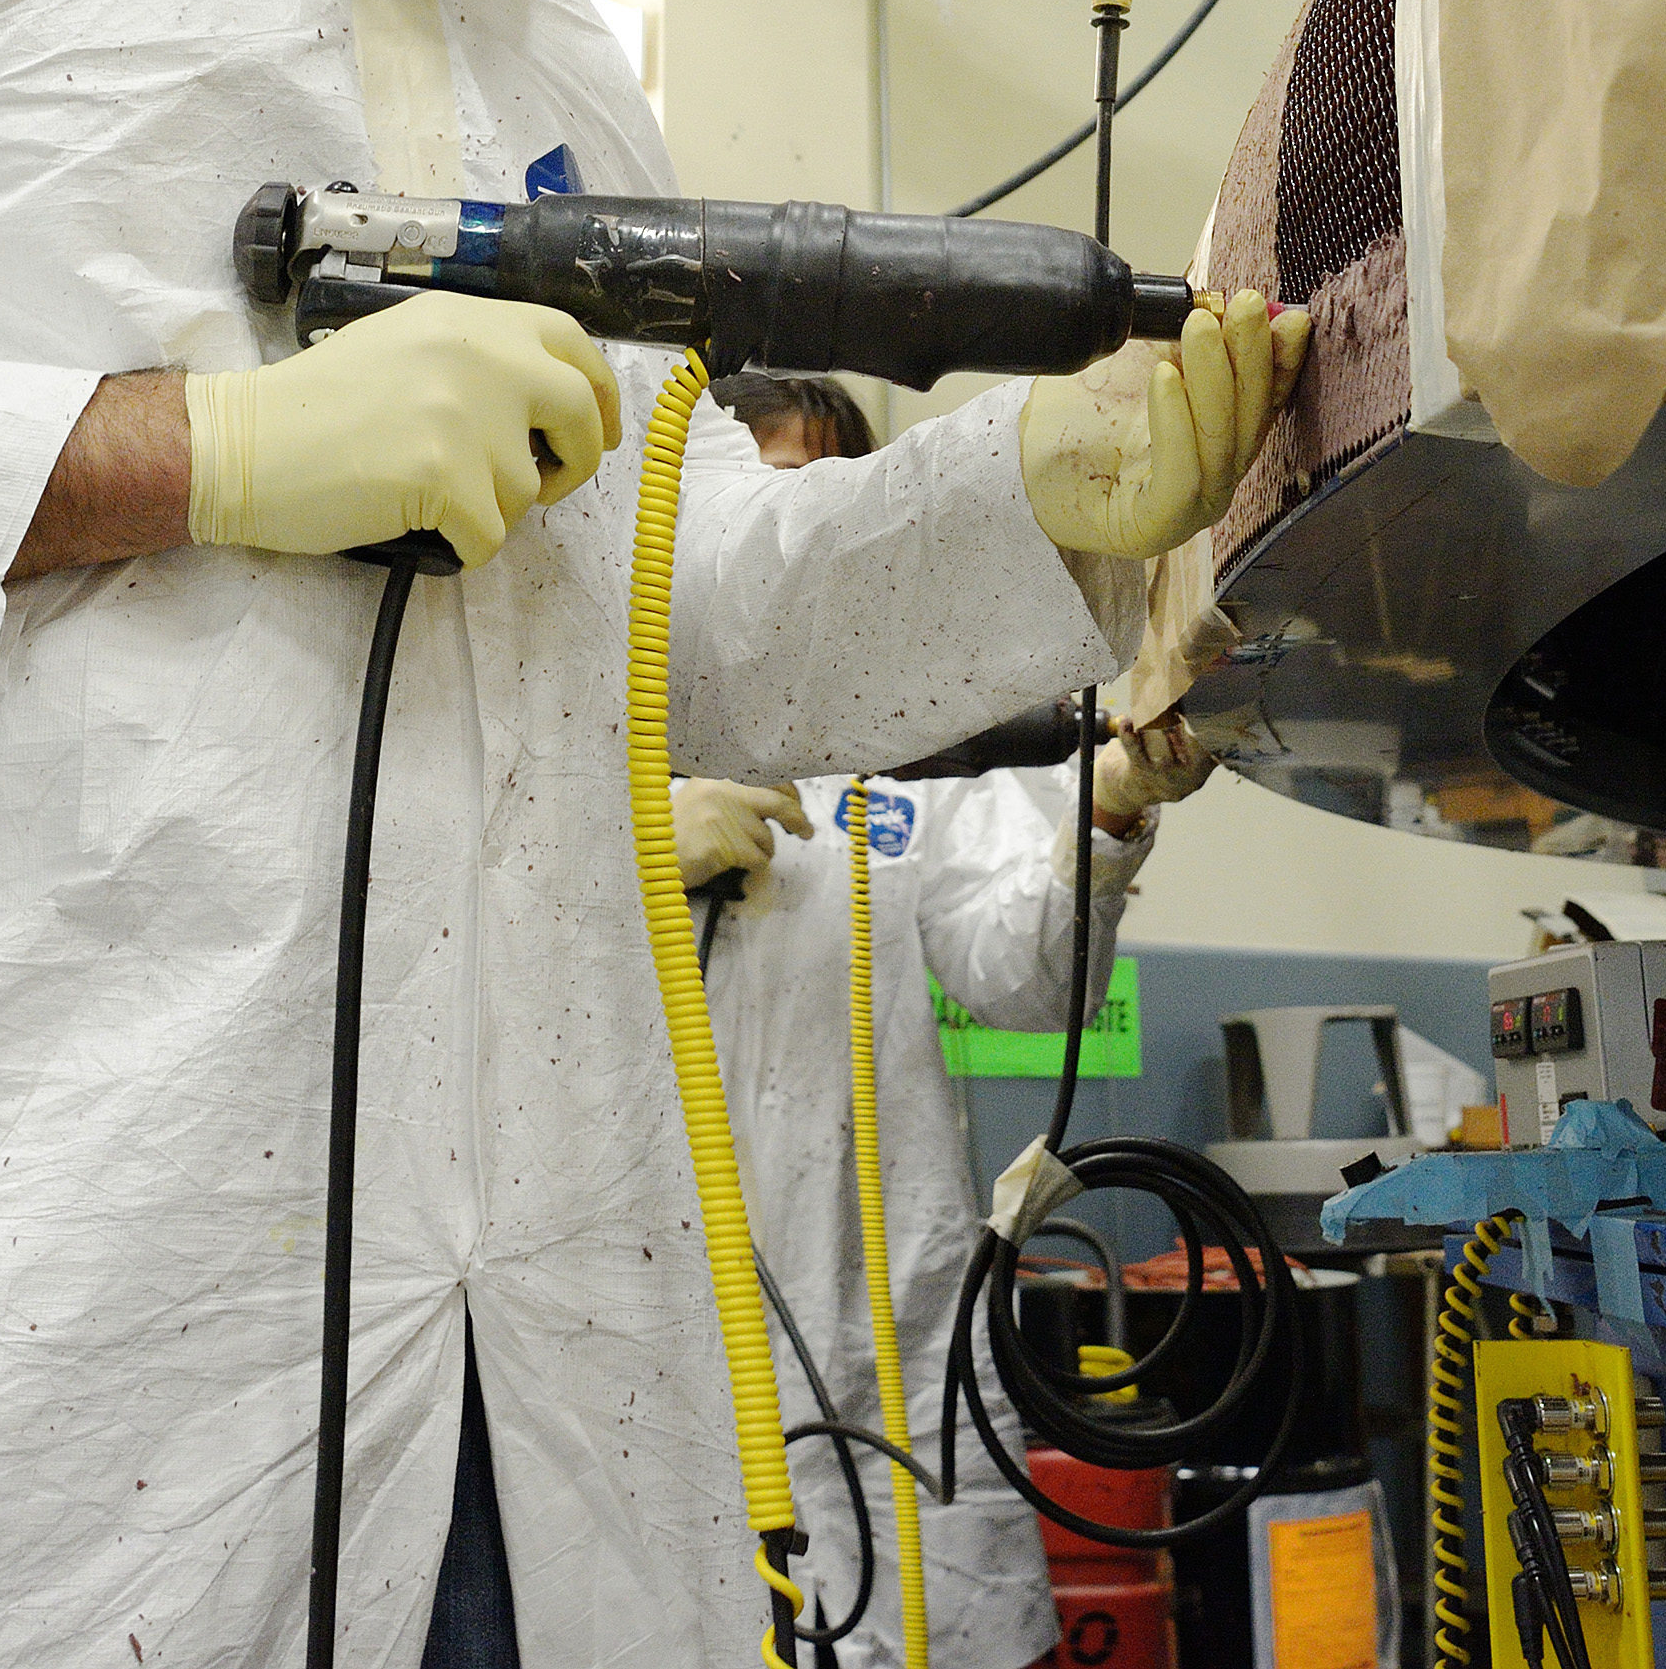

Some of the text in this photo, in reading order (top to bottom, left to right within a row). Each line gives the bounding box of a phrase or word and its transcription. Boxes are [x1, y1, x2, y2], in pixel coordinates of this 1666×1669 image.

[346, 201, 392, 213] Pneumatic
[393, 205, 426, 216] Sealant
[428, 208, 446, 217] Gun
